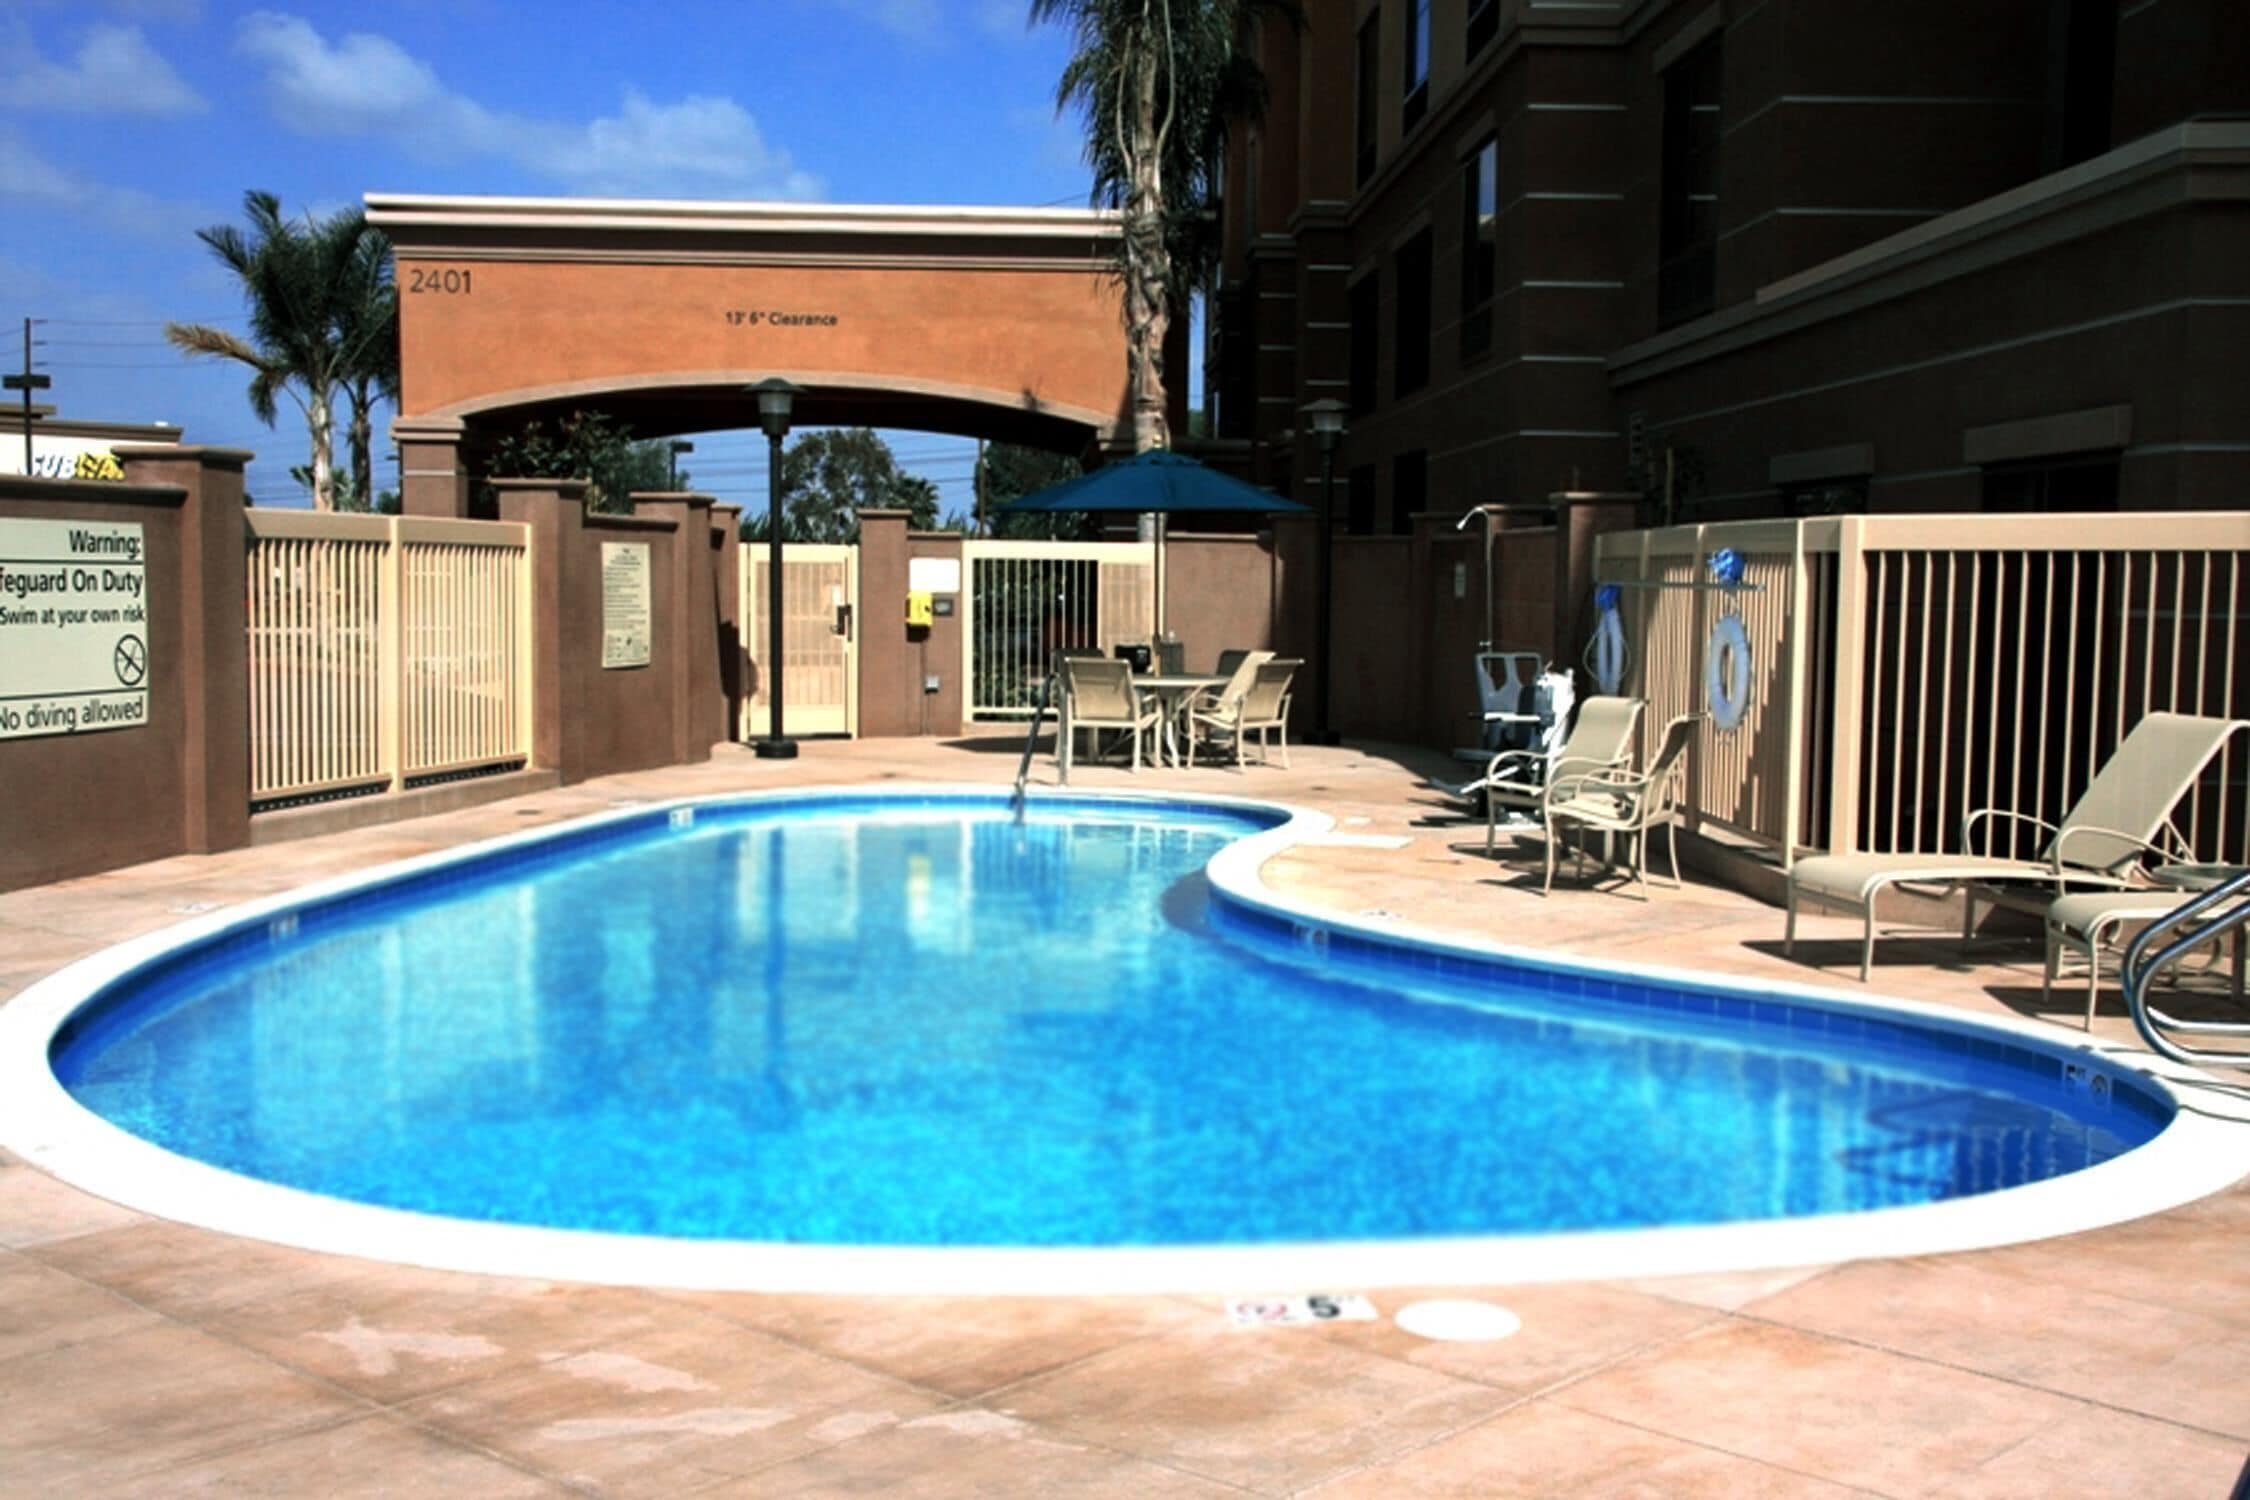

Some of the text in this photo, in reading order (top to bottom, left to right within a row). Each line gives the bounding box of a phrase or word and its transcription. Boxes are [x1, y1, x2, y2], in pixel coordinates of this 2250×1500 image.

[410, 268, 471, 294] 2401
[768, 311, 838, 327] Clearance
[71, 568, 98, 592] On
[102, 569, 143, 598] Duty
[0, 605, 145, 628] Swim at your own risk
[26, 702, 76, 732] diving
[82, 695, 143, 724] allowed
[1307, 1295, 1340, 1319] 5
